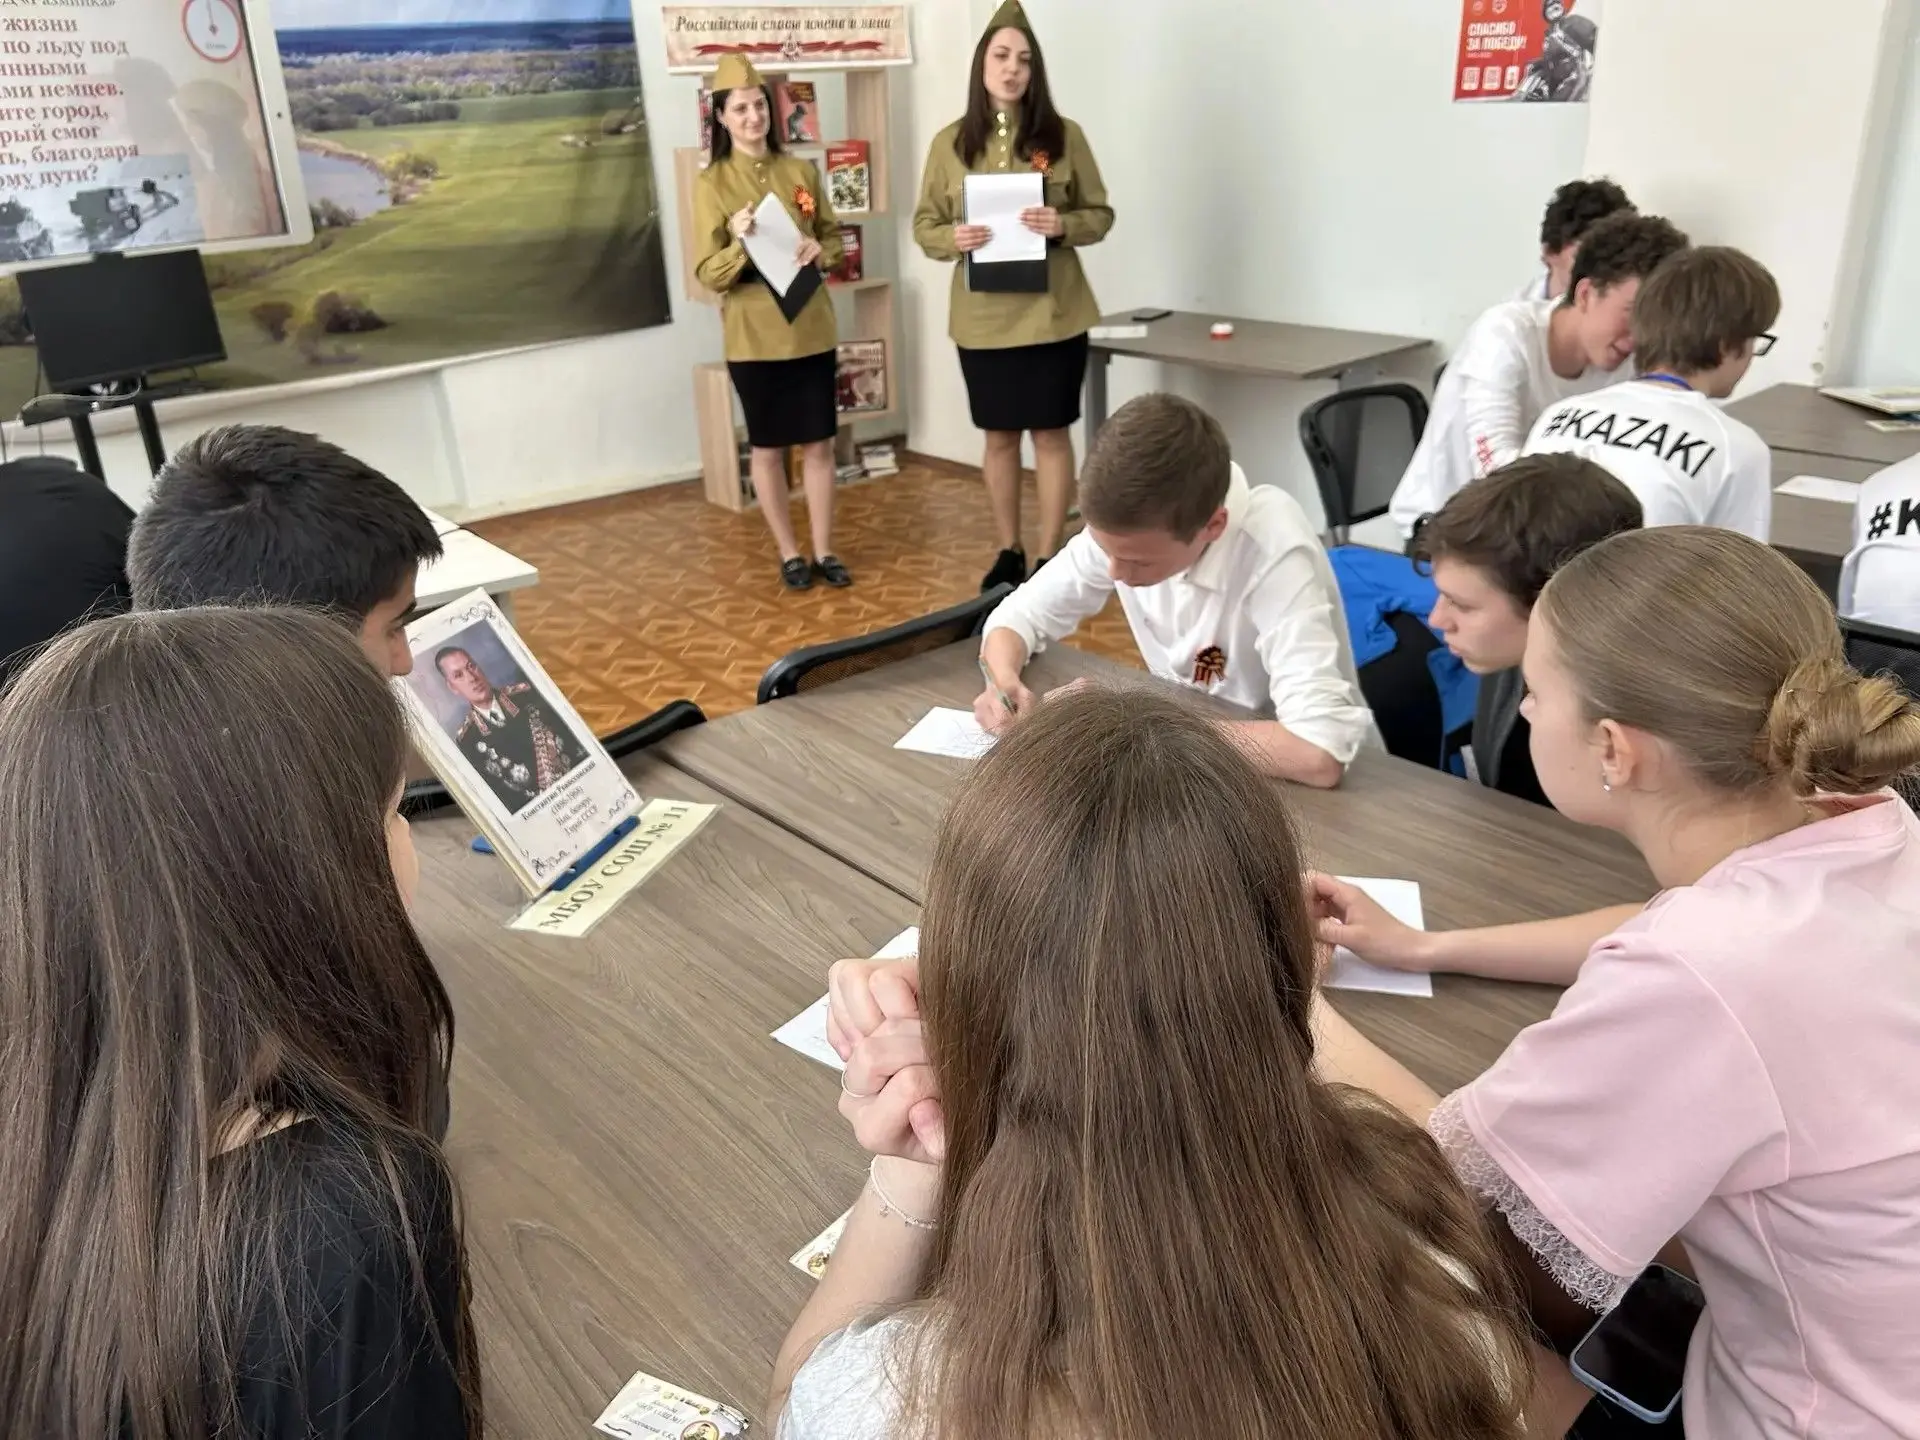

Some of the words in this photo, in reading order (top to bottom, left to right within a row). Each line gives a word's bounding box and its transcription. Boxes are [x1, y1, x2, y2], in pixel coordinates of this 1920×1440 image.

[4, 18, 78, 32] жизни
[675, 15, 758, 32] Российской
[1467, 21, 1517, 37] СПАСИБО
[3, 40, 30, 54] по
[37, 40, 84, 58] льду
[91, 40, 130, 56] под
[1466, 37, 1481, 51] ЗА
[40, 83, 124, 98] немцев.
[41, 104, 109, 123] город,
[51, 125, 100, 140] смог
[40, 163, 98, 187] пути?
[1541, 406, 1717, 479] #KAZAKI
[521, 791, 559, 821] Константин
[538, 878, 604, 929] МБОУ
[601, 839, 652, 877] СОШ
[663, 806, 689, 819] 11
